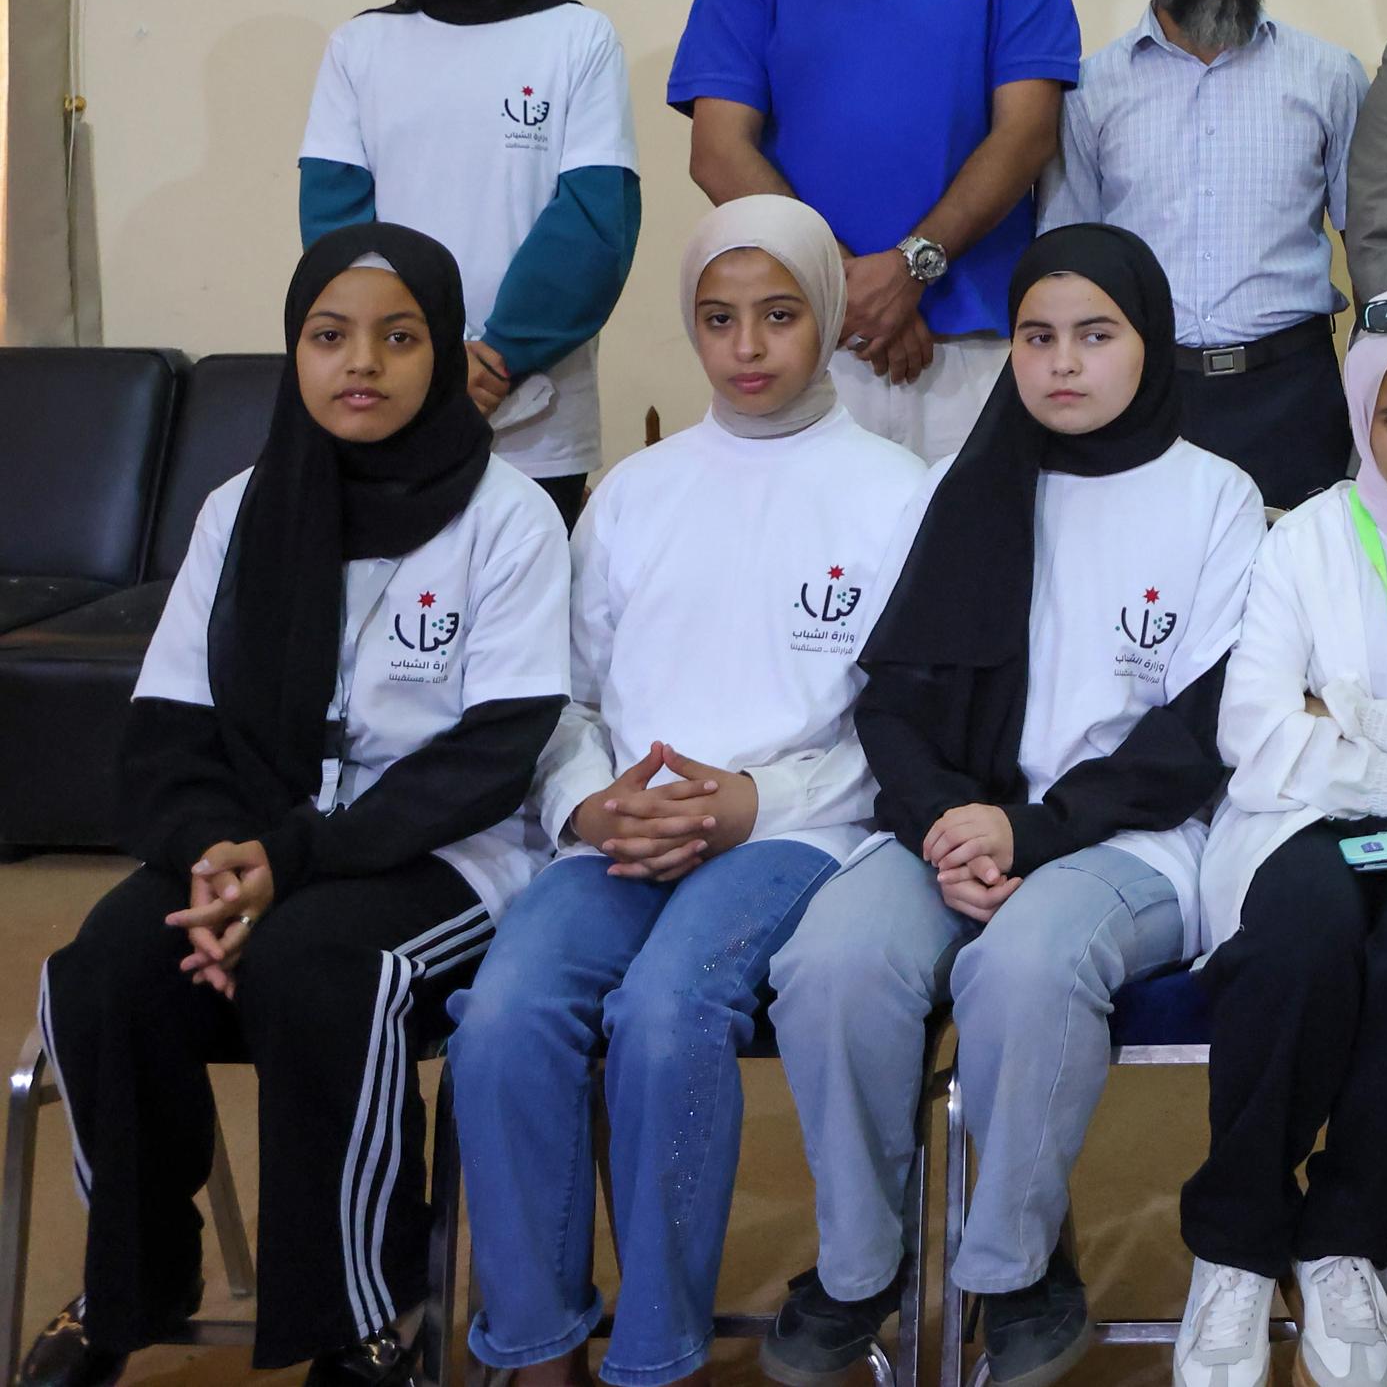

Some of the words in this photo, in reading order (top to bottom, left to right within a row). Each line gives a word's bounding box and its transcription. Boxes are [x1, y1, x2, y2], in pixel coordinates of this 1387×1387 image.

[792, 627, 829, 641] الشباب
[831, 628, 855, 644] وزارة
[390, 659, 430, 671] الشباب
[433, 661, 449, 673] ارة
[1143, 658, 1166, 673] وزارة
